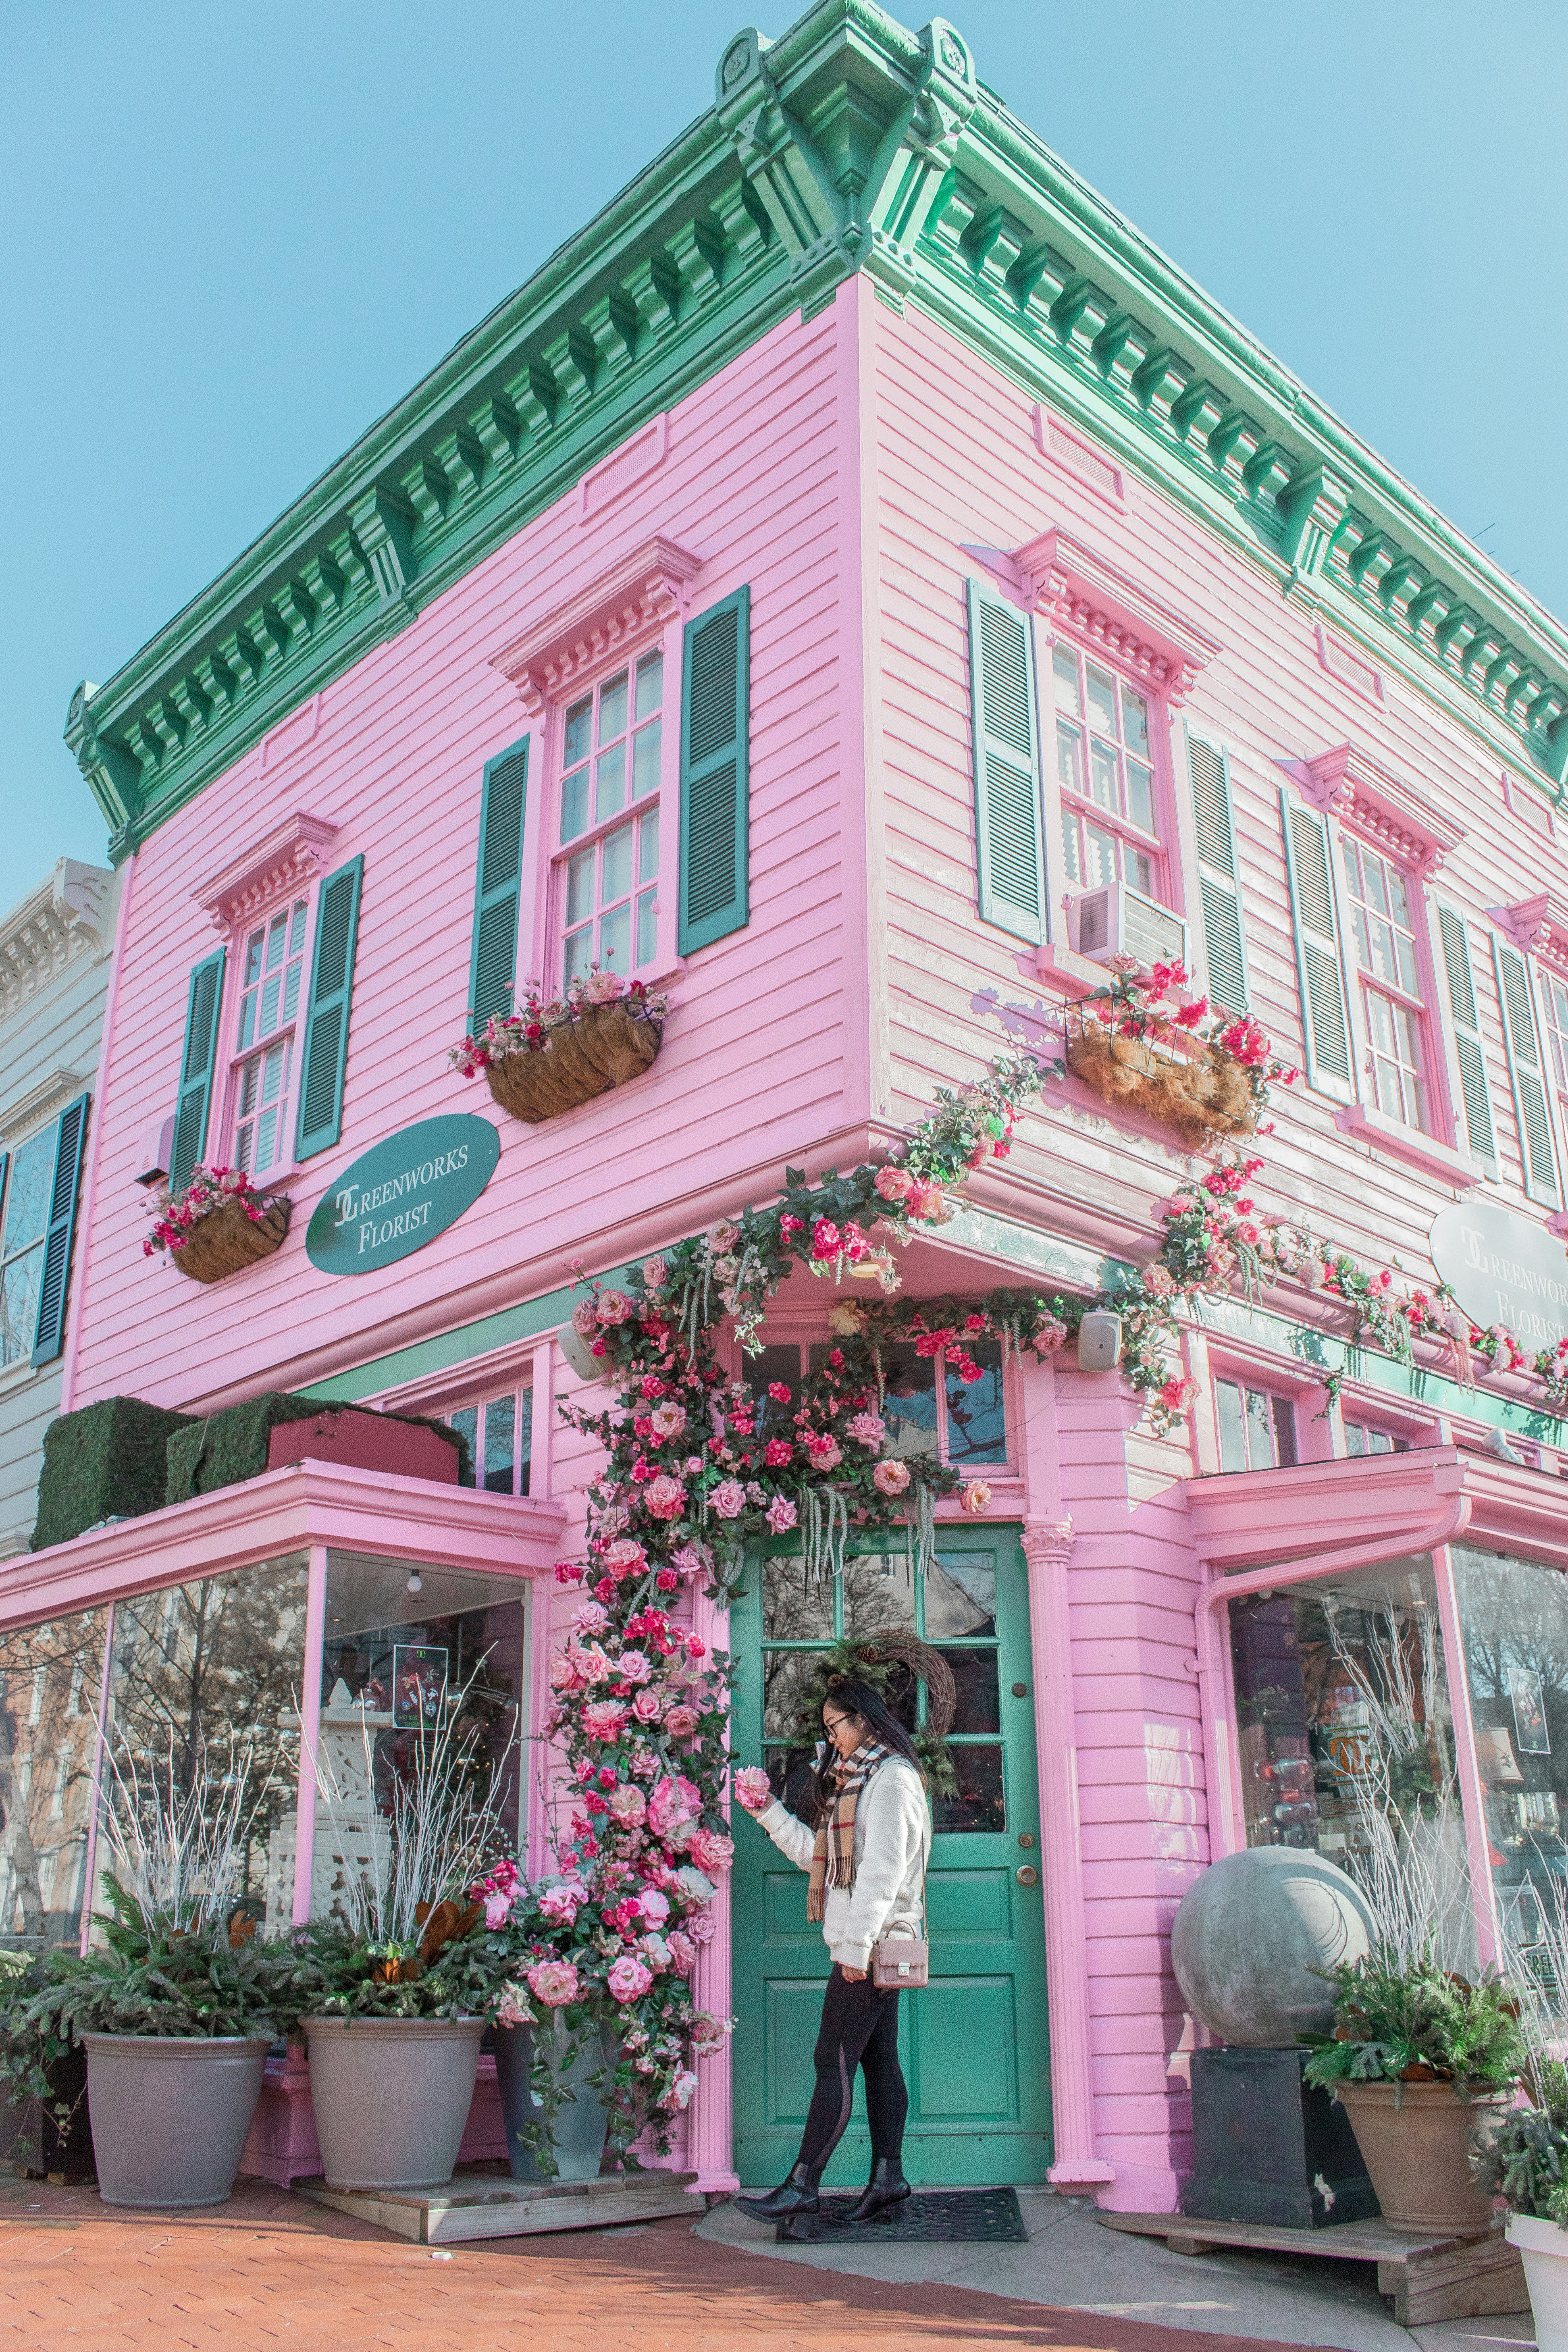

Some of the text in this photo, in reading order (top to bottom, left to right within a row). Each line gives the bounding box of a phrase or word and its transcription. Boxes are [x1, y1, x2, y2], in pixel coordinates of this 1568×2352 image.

[334, 1144, 468, 1227] GREENWORKS
[357, 1201, 432, 1254] FLORIST
[1495, 1289, 1565, 1345] FLORIST
